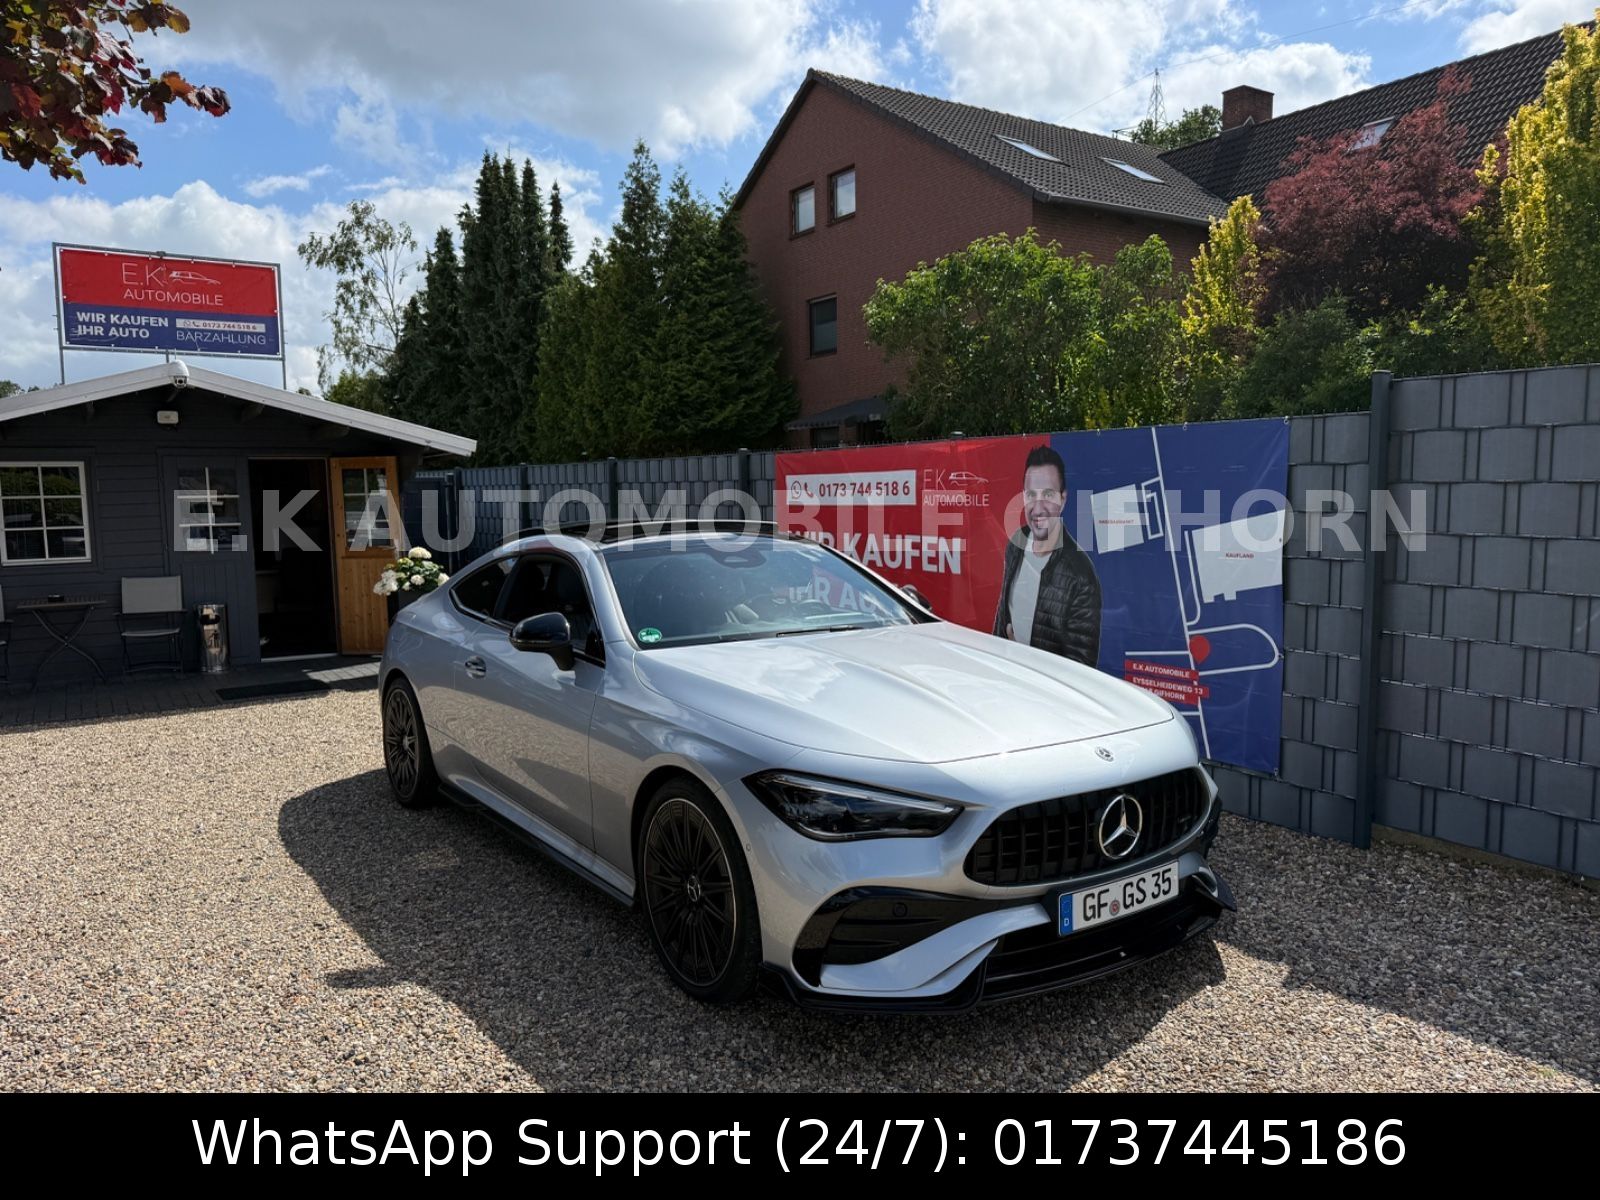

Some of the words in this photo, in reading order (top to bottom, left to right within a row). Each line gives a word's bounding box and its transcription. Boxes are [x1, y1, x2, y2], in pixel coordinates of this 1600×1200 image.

[123, 288, 224, 306] AUTOMOBILE
[76, 311, 106, 324] WIR
[110, 313, 169, 327] KAUFEN
[77, 325, 104, 336] IHR
[108, 327, 150, 338] AUTO
[176, 330, 267, 345] BARZAHLUNG
[818, 483, 847, 498] 0173
[851, 482, 872, 496] 744
[875, 482, 899, 496] 518
[902, 481, 910, 496] 6
[922, 493, 990, 508] AUTOMOBILE
[844, 533, 961, 575] KAUFEN
[1144, 666, 1190, 678] AUTOMOBILE
[1194, 687, 1204, 695] 13
[1083, 888, 1110, 921] GF
[1123, 877, 1147, 910] GS
[1151, 867, 1172, 899] 35
[1063, 918, 1070, 927] D
